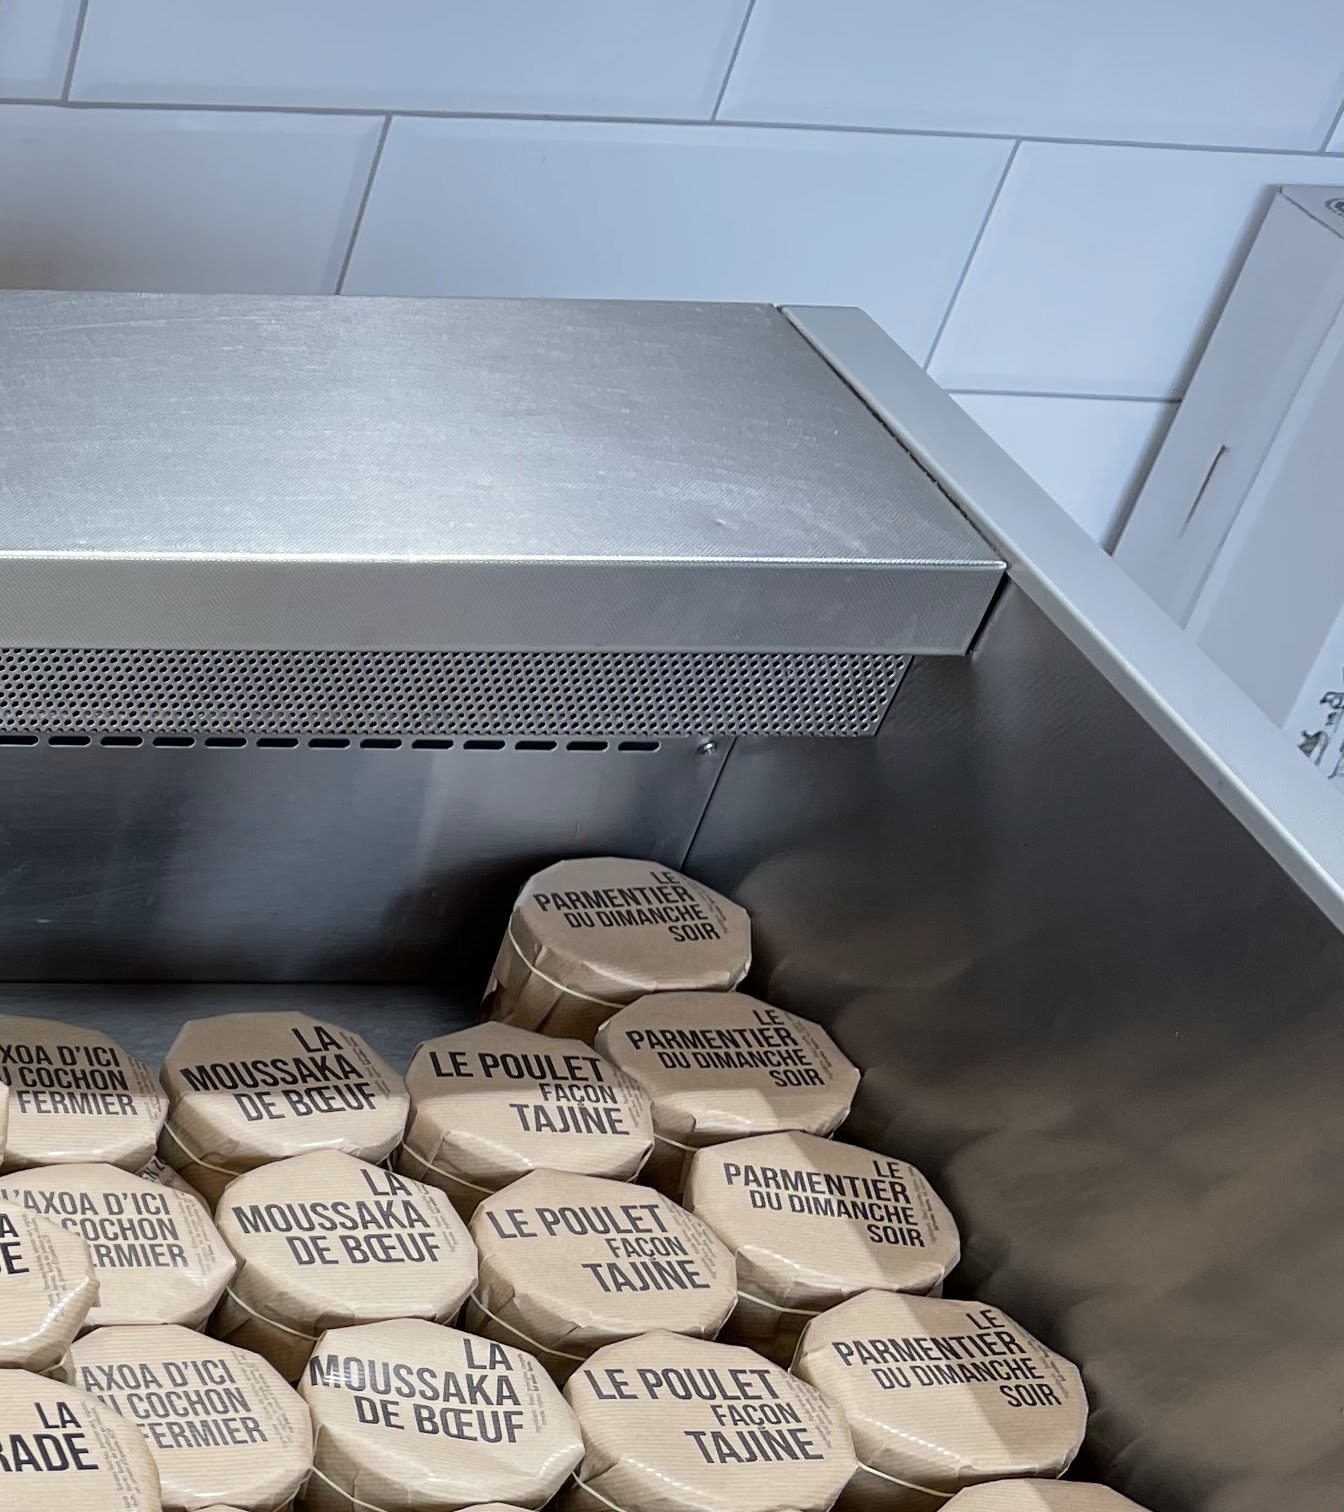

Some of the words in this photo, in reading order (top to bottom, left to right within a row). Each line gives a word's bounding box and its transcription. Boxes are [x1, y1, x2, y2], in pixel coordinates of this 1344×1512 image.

[651, 871, 680, 884] LE
[533, 885, 696, 912] PARMENTIER
[564, 910, 595, 928] DU
[598, 904, 709, 928] DIMANCHE
[668, 922, 721, 942] SOIR
[291, 1026, 343, 1053] LA
[18, 1067, 129, 1091] COCHON
[180, 1054, 364, 1092] MOUSSAKA
[429, 1052, 476, 1078] LE
[478, 1053, 605, 1082] POULET
[16, 1090, 138, 1115] FERMIER
[233, 1092, 286, 1121] DE
[282, 1083, 376, 1117] BŒUF
[539, 1084, 619, 1107] FAÇON
[509, 1104, 630, 1135] TAJINE
[723, 1162, 912, 1204] PARMENTIER
[873, 1160, 903, 1179] LE
[749, 1189, 782, 1211] DU
[789, 1194, 918, 1226] DIMANCHE
[867, 1224, 925, 1247] SOIR
[463, 1339, 513, 1370] LA
[309, 1355, 521, 1406] MOUSSAKA
[584, 1369, 638, 1400] LE
[637, 1368, 781, 1400] POULET
[354, 1396, 405, 1429] DE
[413, 1404, 524, 1443] BŒUF
[710, 1404, 802, 1429] FAÇON
[684, 1428, 825, 1464] TAJINE
